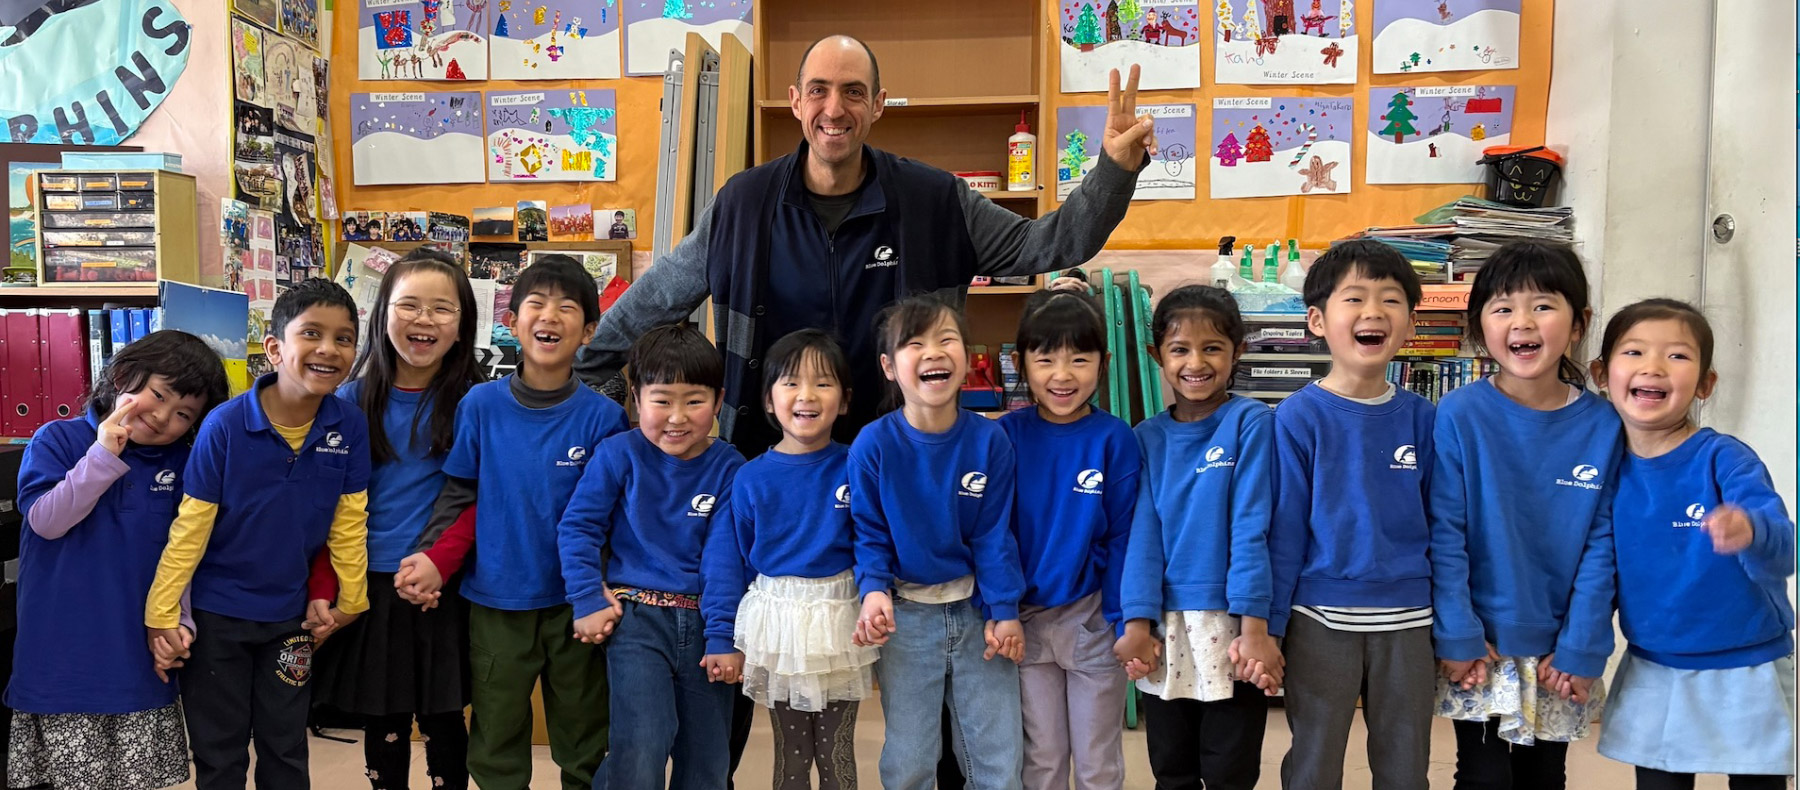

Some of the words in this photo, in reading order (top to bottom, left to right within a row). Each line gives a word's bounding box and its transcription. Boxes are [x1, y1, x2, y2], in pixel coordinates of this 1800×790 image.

[1263, 71, 1288, 79] Winter
[1291, 70, 1315, 79] Scene
[1420, 87, 1445, 95] Winter
[1448, 86, 1472, 94] Scene
[375, 93, 399, 101] Winter
[401, 92, 423, 101] Scene
[494, 96, 517, 104] Winter
[520, 94, 541, 103] Scene
[1217, 98, 1243, 106] Winter
[1246, 97, 1269, 105] Scene
[1135, 107, 1160, 115] Winter
[1163, 106, 1186, 115] Scene
[1262, 330, 1284, 338] Ongoing
[1286, 330, 1303, 338] Topics
[1555, 478, 1573, 486] Blue
